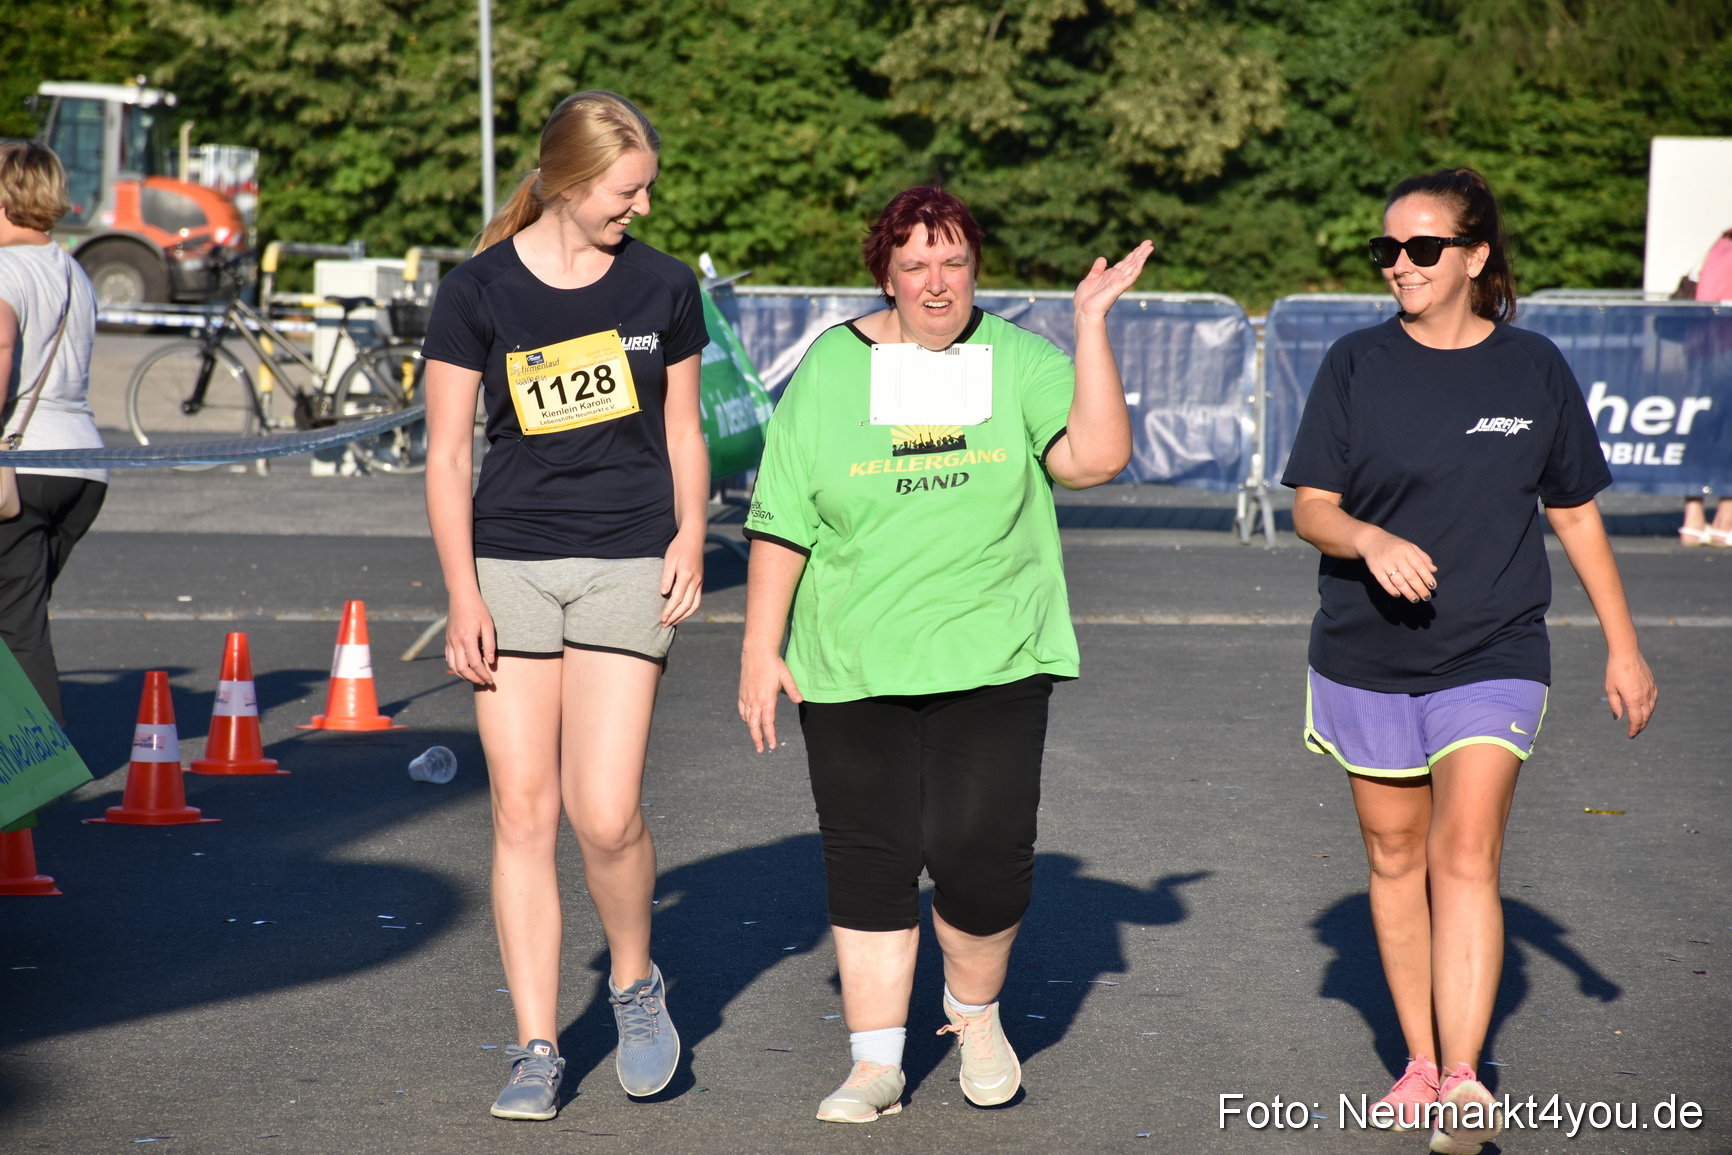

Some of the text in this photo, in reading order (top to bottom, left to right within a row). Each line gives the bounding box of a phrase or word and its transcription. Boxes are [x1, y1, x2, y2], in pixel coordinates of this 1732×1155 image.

[619, 335, 652, 350] URA
[521, 358, 560, 374] firmenlauf
[527, 364, 616, 410] 1128
[539, 413, 575, 426] Lebenshilfe
[575, 407, 604, 420] Neumarkt
[541, 397, 612, 419] Kienlein Karolin
[849, 447, 1007, 477] KELLERGANG
[895, 472, 970, 495] BAND
